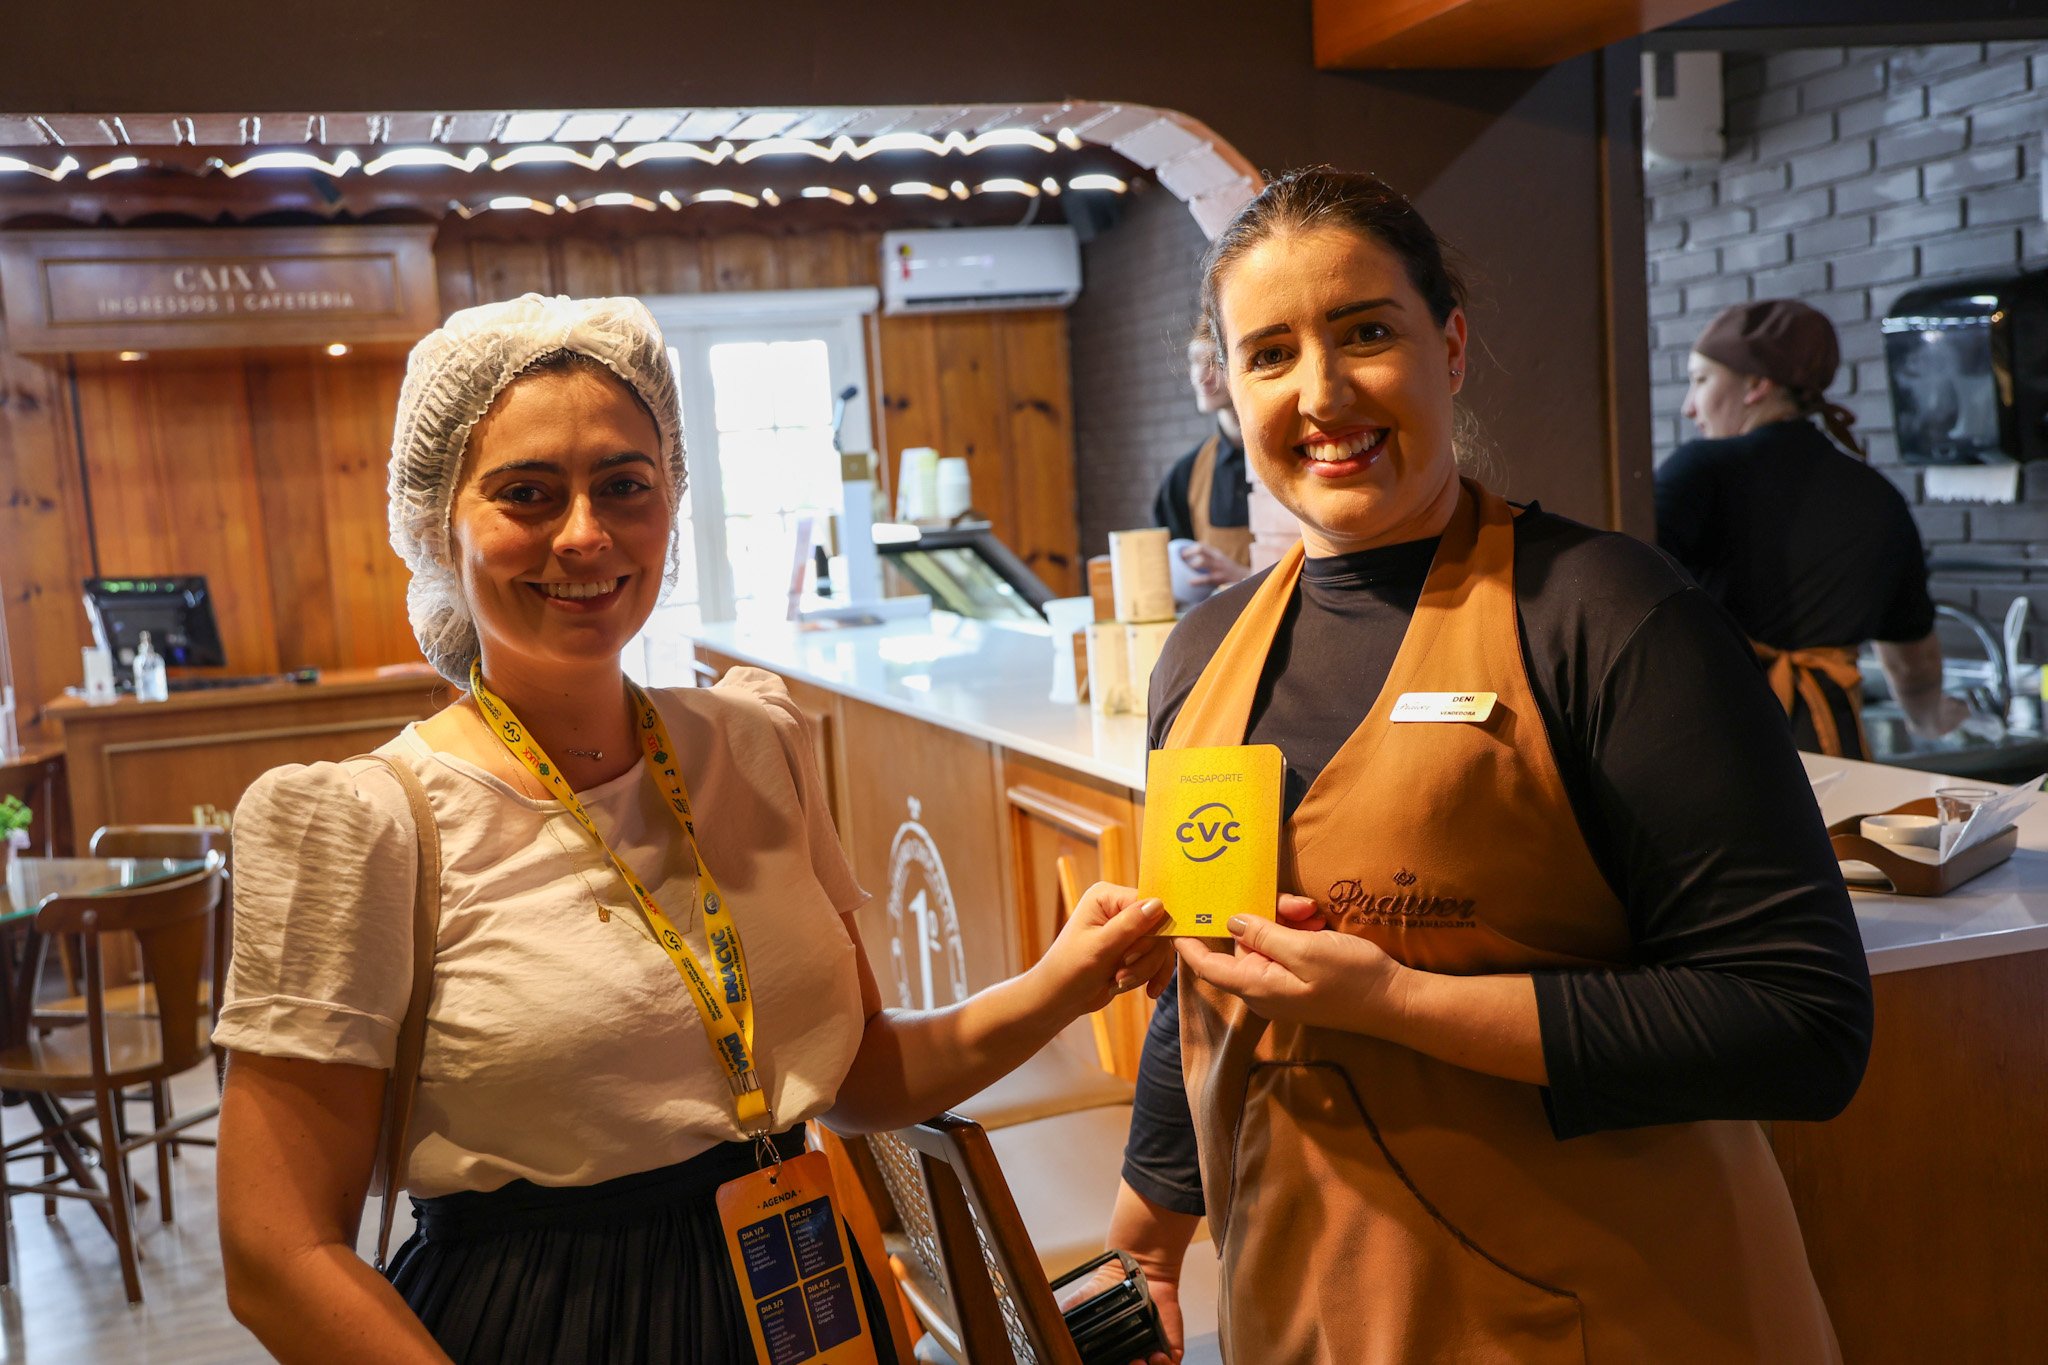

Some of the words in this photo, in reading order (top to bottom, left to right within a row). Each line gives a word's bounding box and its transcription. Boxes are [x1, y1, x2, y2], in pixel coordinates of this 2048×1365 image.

[174, 265, 277, 292] CAIXA
[99, 297, 218, 315] INGRESSOS
[244, 292, 354, 311] CAFETERIA
[503, 721, 520, 742] CVC
[522, 748, 540, 768] LUCK
[1180, 774, 1243, 784] PASSAPORTE
[1176, 822, 1241, 843] CVC
[643, 896, 660, 915] LUCK
[664, 929, 682, 952] CVC
[731, 946, 739, 963] fazer
[738, 974, 747, 1001] Orgulho
[703, 988, 710, 996] DE
[708, 996, 723, 1018] VENDAS
[716, 1038, 730, 1062] Orgulho
[724, 1032, 749, 1074] DNA
[761, 1189, 797, 1209] AGENDA
[789, 1211, 800, 1221] DIA
[802, 1207, 812, 1217] 2/3
[742, 1230, 753, 1240] DIA
[754, 1225, 764, 1236] 1/3
[808, 1283, 818, 1293] DIA
[819, 1278, 830, 1288] 4/3
[761, 1304, 772, 1313] DIA
[773, 1298, 784, 1308] 3/3
